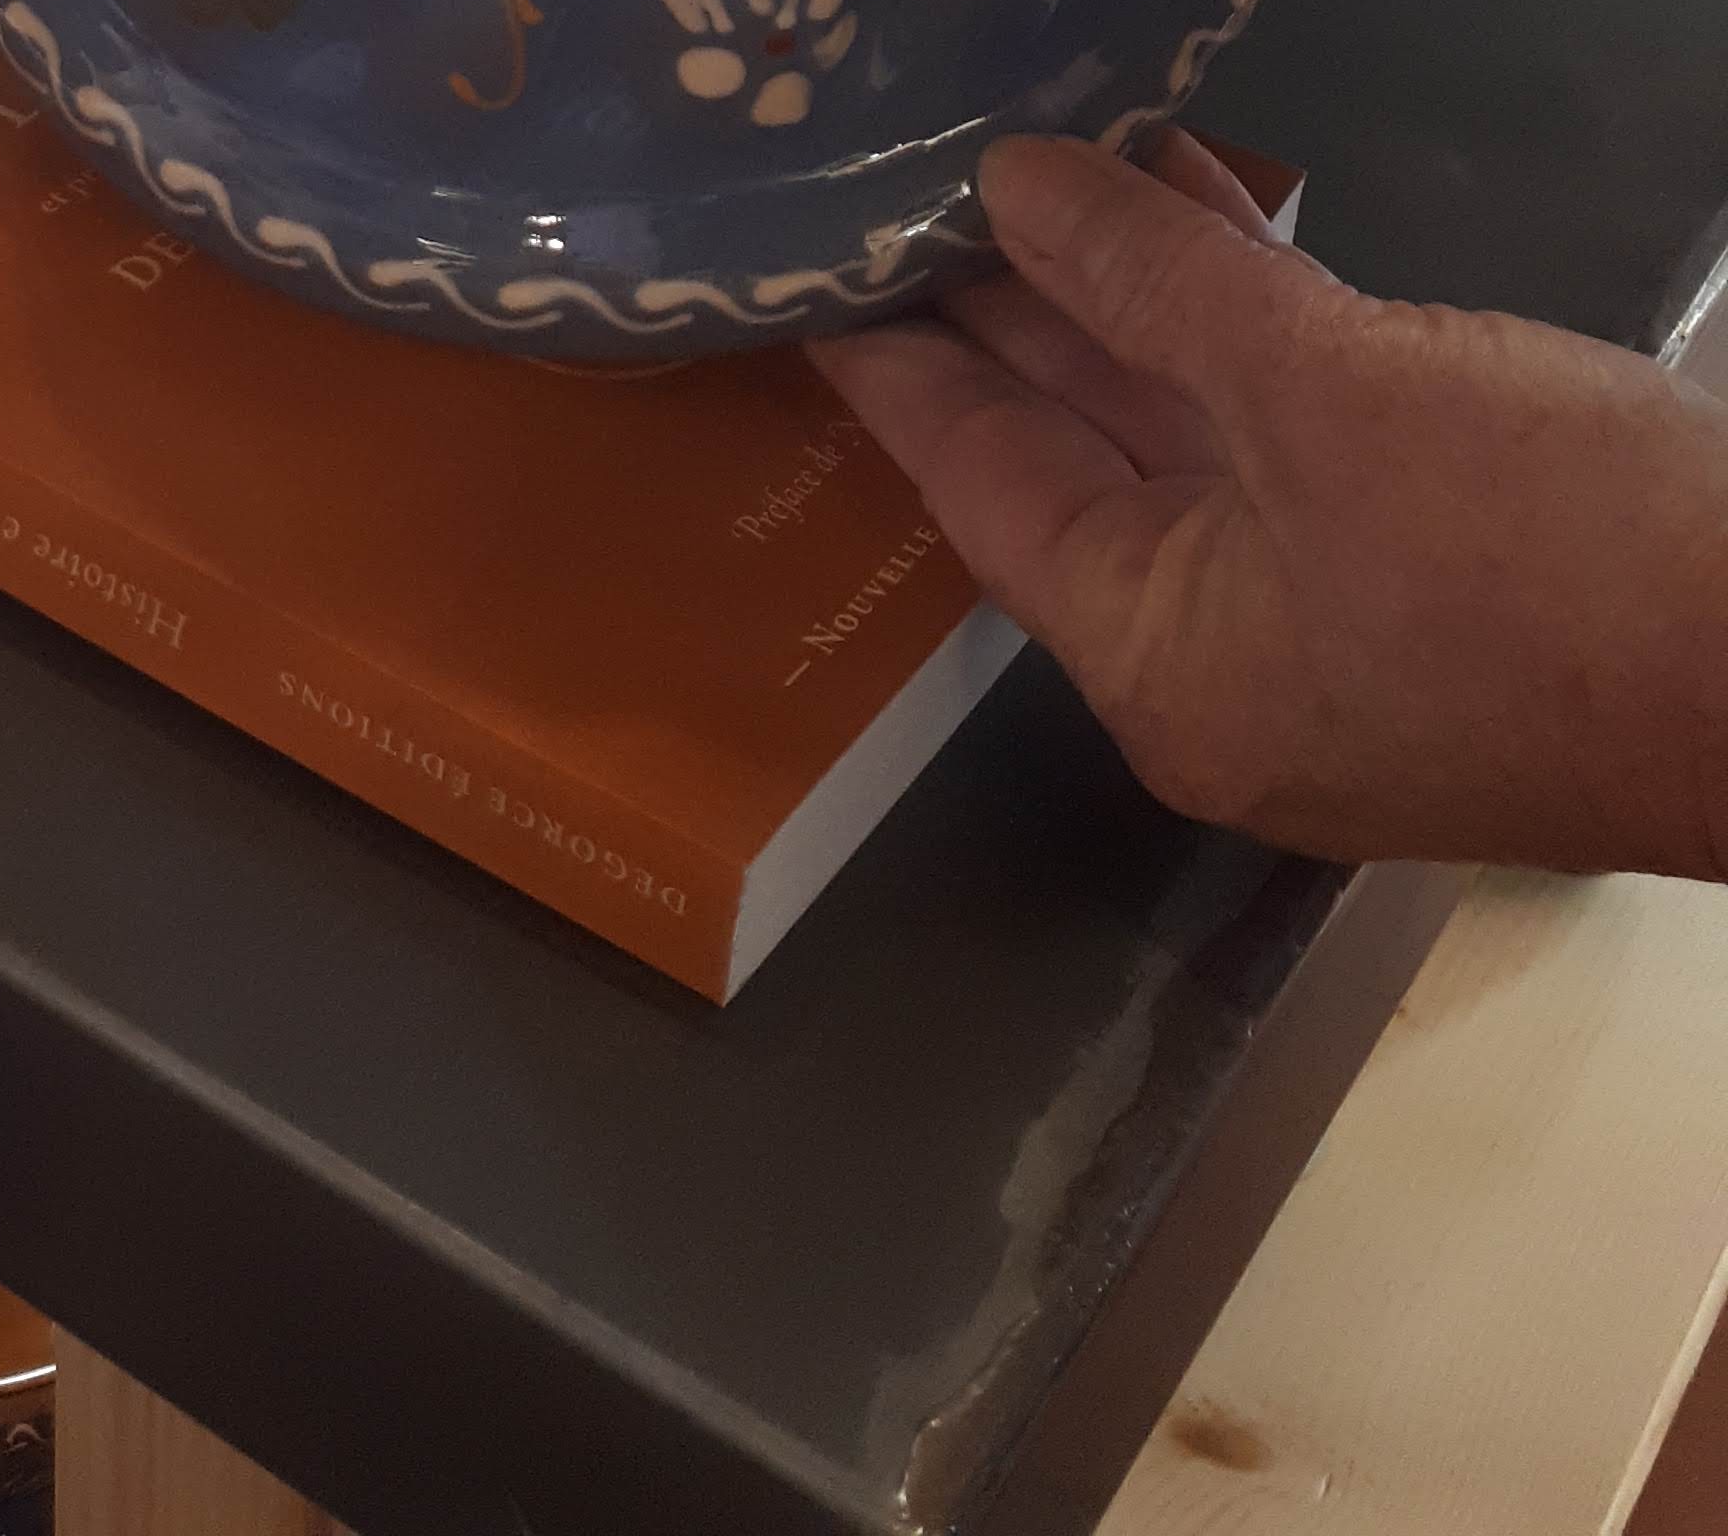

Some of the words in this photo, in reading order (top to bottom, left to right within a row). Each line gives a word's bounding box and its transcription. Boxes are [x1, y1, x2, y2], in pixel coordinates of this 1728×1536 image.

[33, 533, 187, 650] Histoire
[278, 671, 472, 799] ÉDITIONS
[486, 786, 687, 916] DEGORCE
